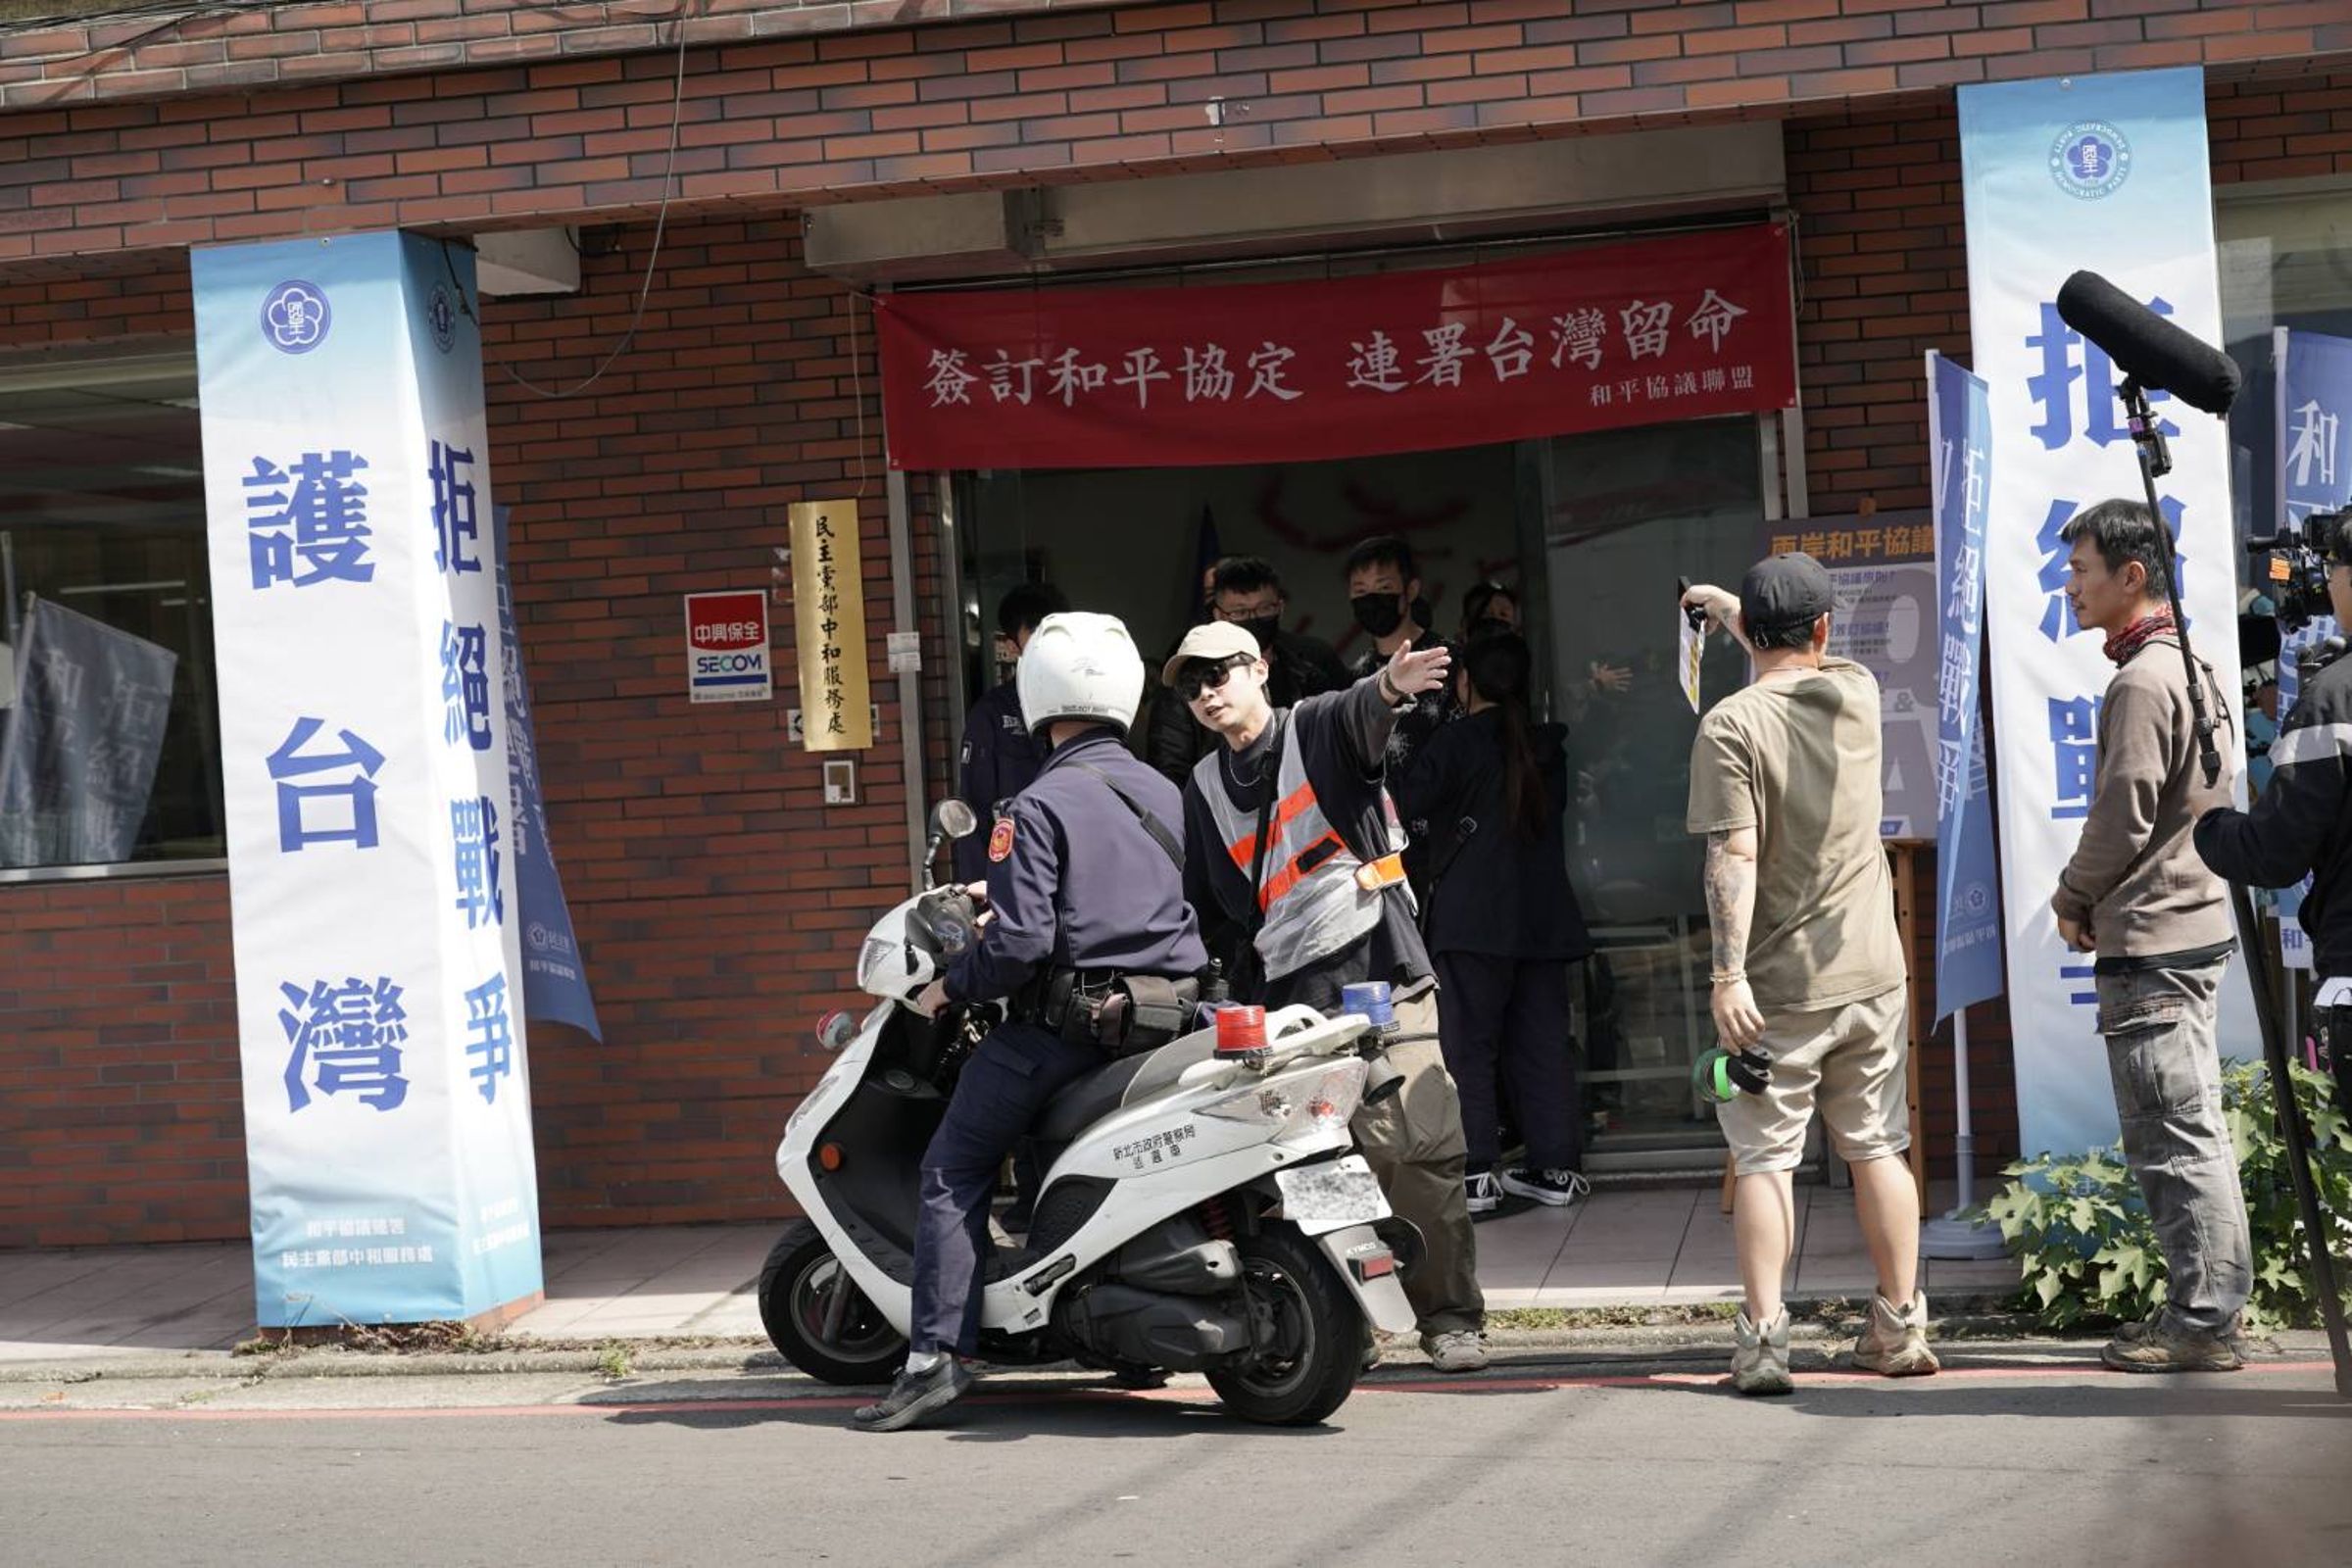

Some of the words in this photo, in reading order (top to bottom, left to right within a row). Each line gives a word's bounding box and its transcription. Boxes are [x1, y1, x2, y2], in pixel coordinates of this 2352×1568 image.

[924, 340, 1304, 410] 簽訂和平協定
[1346, 287, 1749, 395] 連署台灣留命
[1590, 365, 1756, 409] 和平協議聯盟
[694, 621, 760, 643] 中興保全
[697, 654, 762, 673] SECOM
[241, 449, 411, 1114] 護台灣
[427, 438, 514, 1106] 拒絕戰爭
